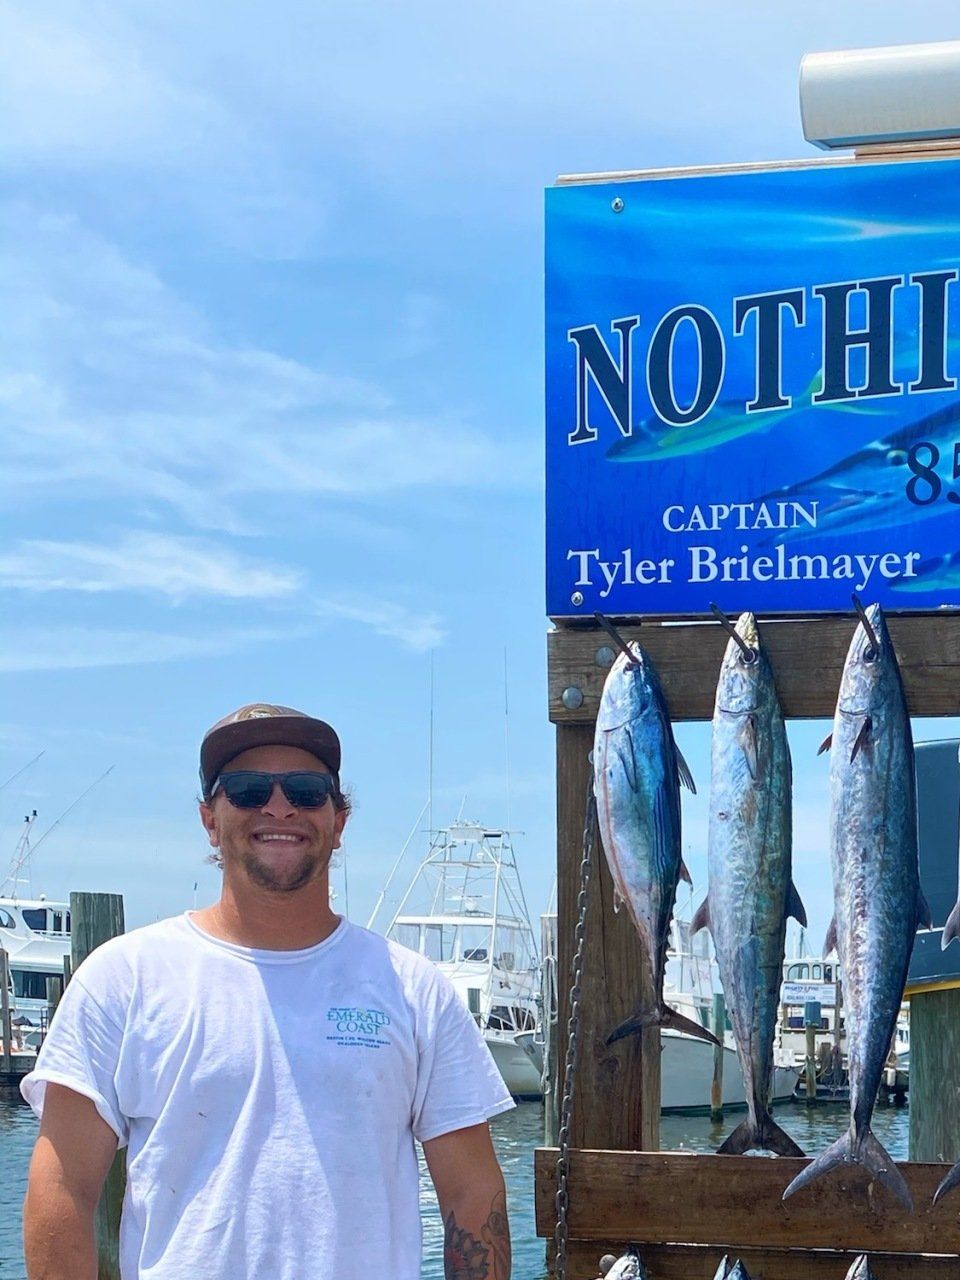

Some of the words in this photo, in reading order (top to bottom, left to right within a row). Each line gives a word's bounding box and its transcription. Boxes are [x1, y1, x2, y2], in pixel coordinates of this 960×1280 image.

[661, 500, 820, 532] CAPTAIN
[566, 547, 675, 598] Tyler
[687, 544, 921, 592] Brielmayer
[326, 1010, 391, 1026] EMERALD
[336, 1021, 381, 1035] COAST
